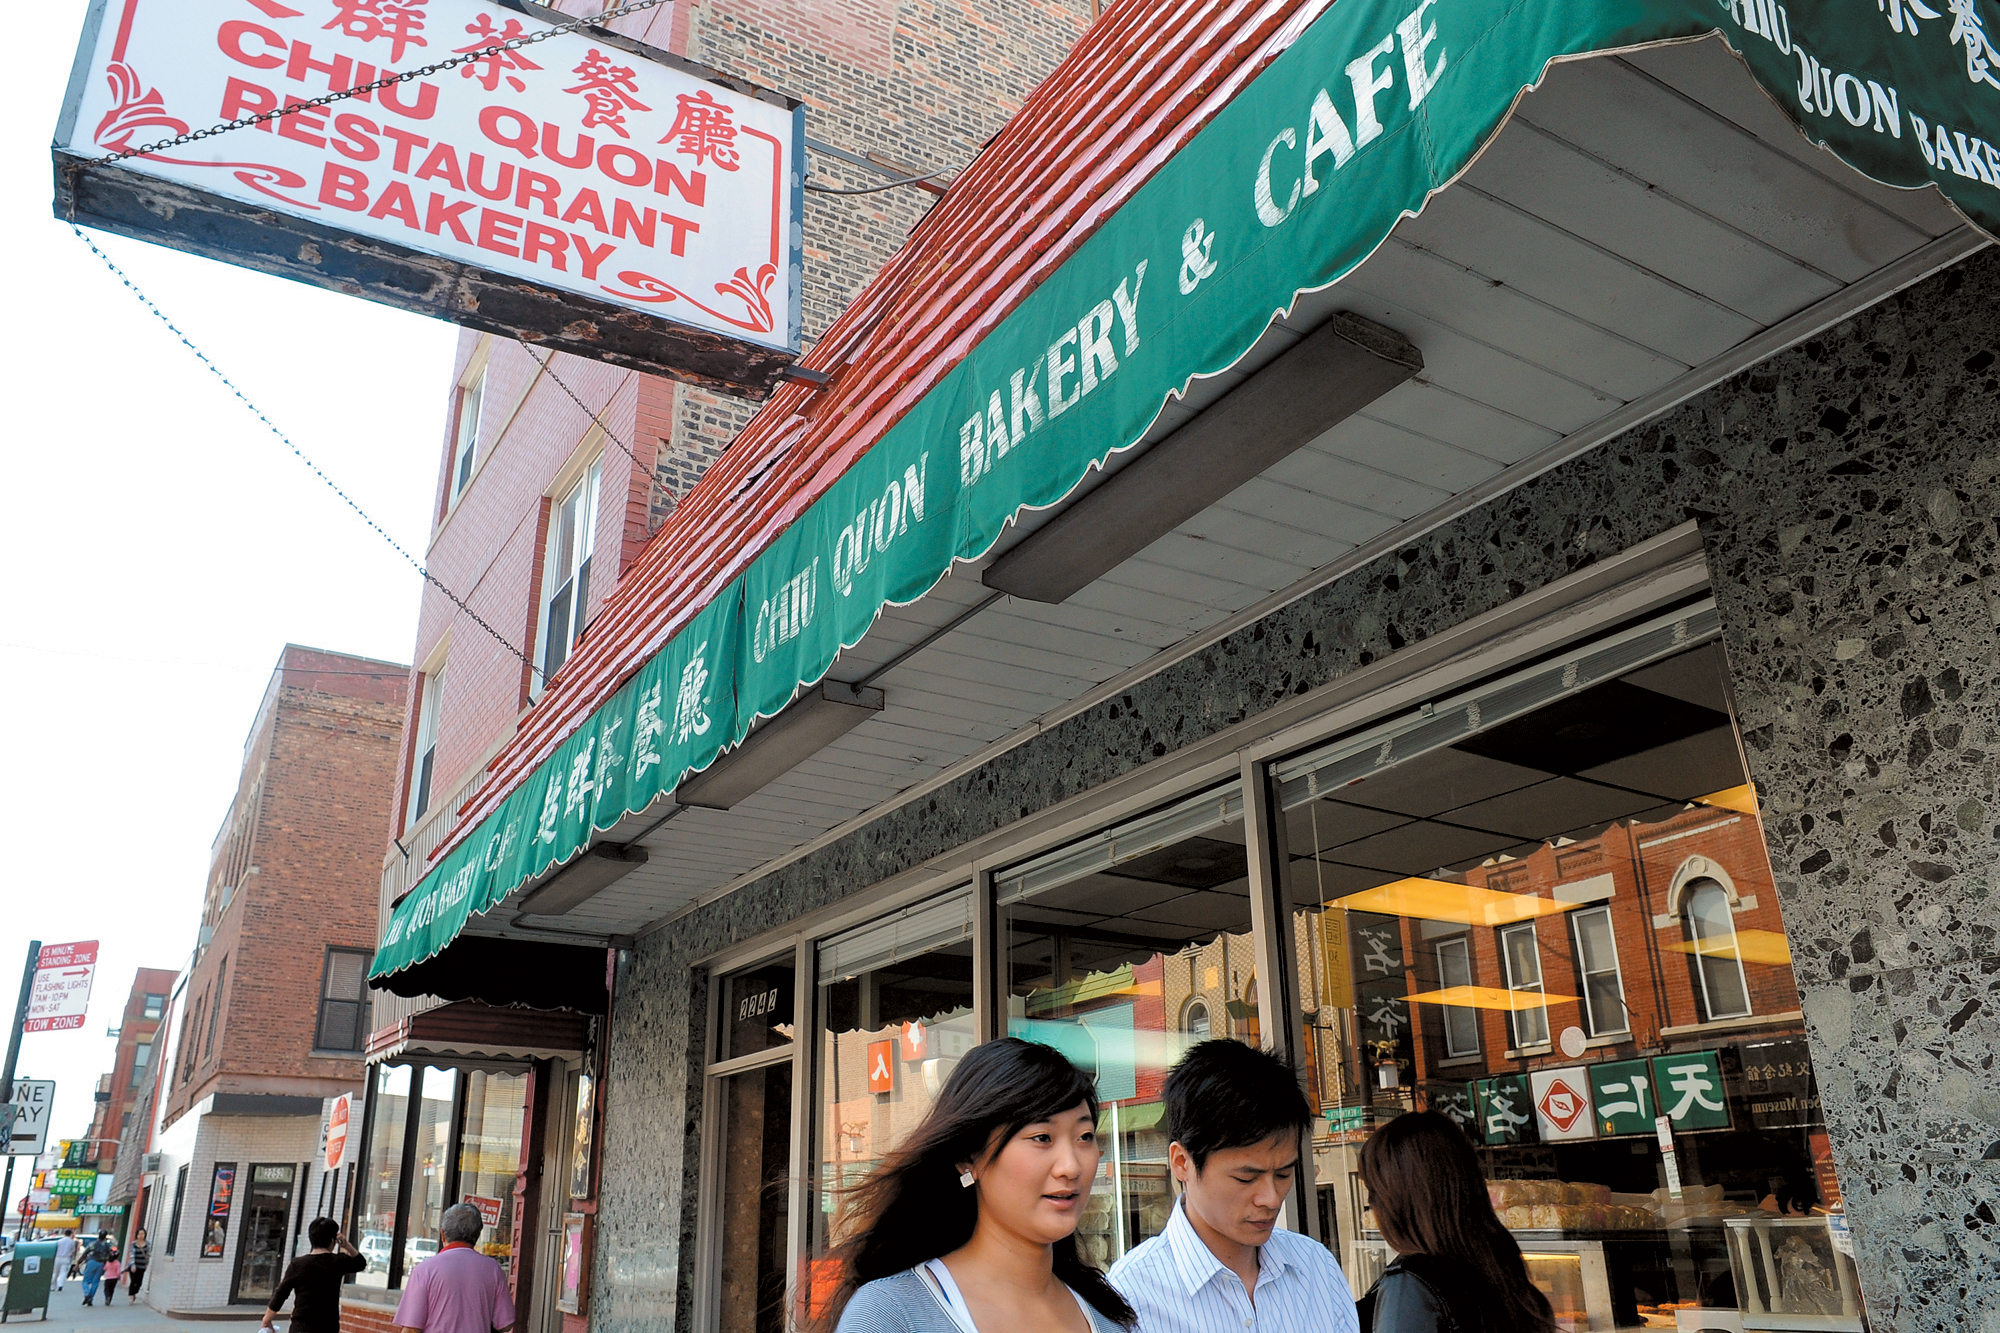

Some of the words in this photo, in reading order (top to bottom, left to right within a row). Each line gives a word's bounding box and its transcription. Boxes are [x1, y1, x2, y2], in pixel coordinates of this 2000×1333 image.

[1719, 0, 1791, 56] HIU
[246, 0, 740, 172] 群茶餐廳
[217, 20, 440, 120] CHIU
[478, 105, 707, 208] QUON
[219, 76, 700, 258] RESTAURANT
[317, 161, 618, 281] BAKERY
[753, 556, 820, 664] CHIU
[833, 450, 929, 597] QUON
[959, 258, 1149, 488] BAKERY
[1178, 217, 1218, 296] &
[1254, 0, 1448, 228] CAFE
[42, 948, 51, 957] 15
[51, 945, 75, 956] MINUTE
[40, 955, 72, 967] STANDING
[73, 953, 92, 963] ZONE
[35, 982, 65, 993] FLASHING
[67, 979, 89, 990] LIGHTS
[38, 973, 51, 983] USE
[31, 1003, 61, 1014] MON-SAT
[740, 990, 776, 1020] 2242
[28, 1018, 50, 1031] TOW
[52, 1016, 80, 1029] ZONE
[11, 1085, 45, 1102] NE
[14, 1106, 44, 1123] AY
[212, 1171, 234, 1216] OPEN
[77, 1204, 98, 1214] DIM
[99, 1204, 123, 1214] SUM
[481, 1212, 497, 1224] EN
